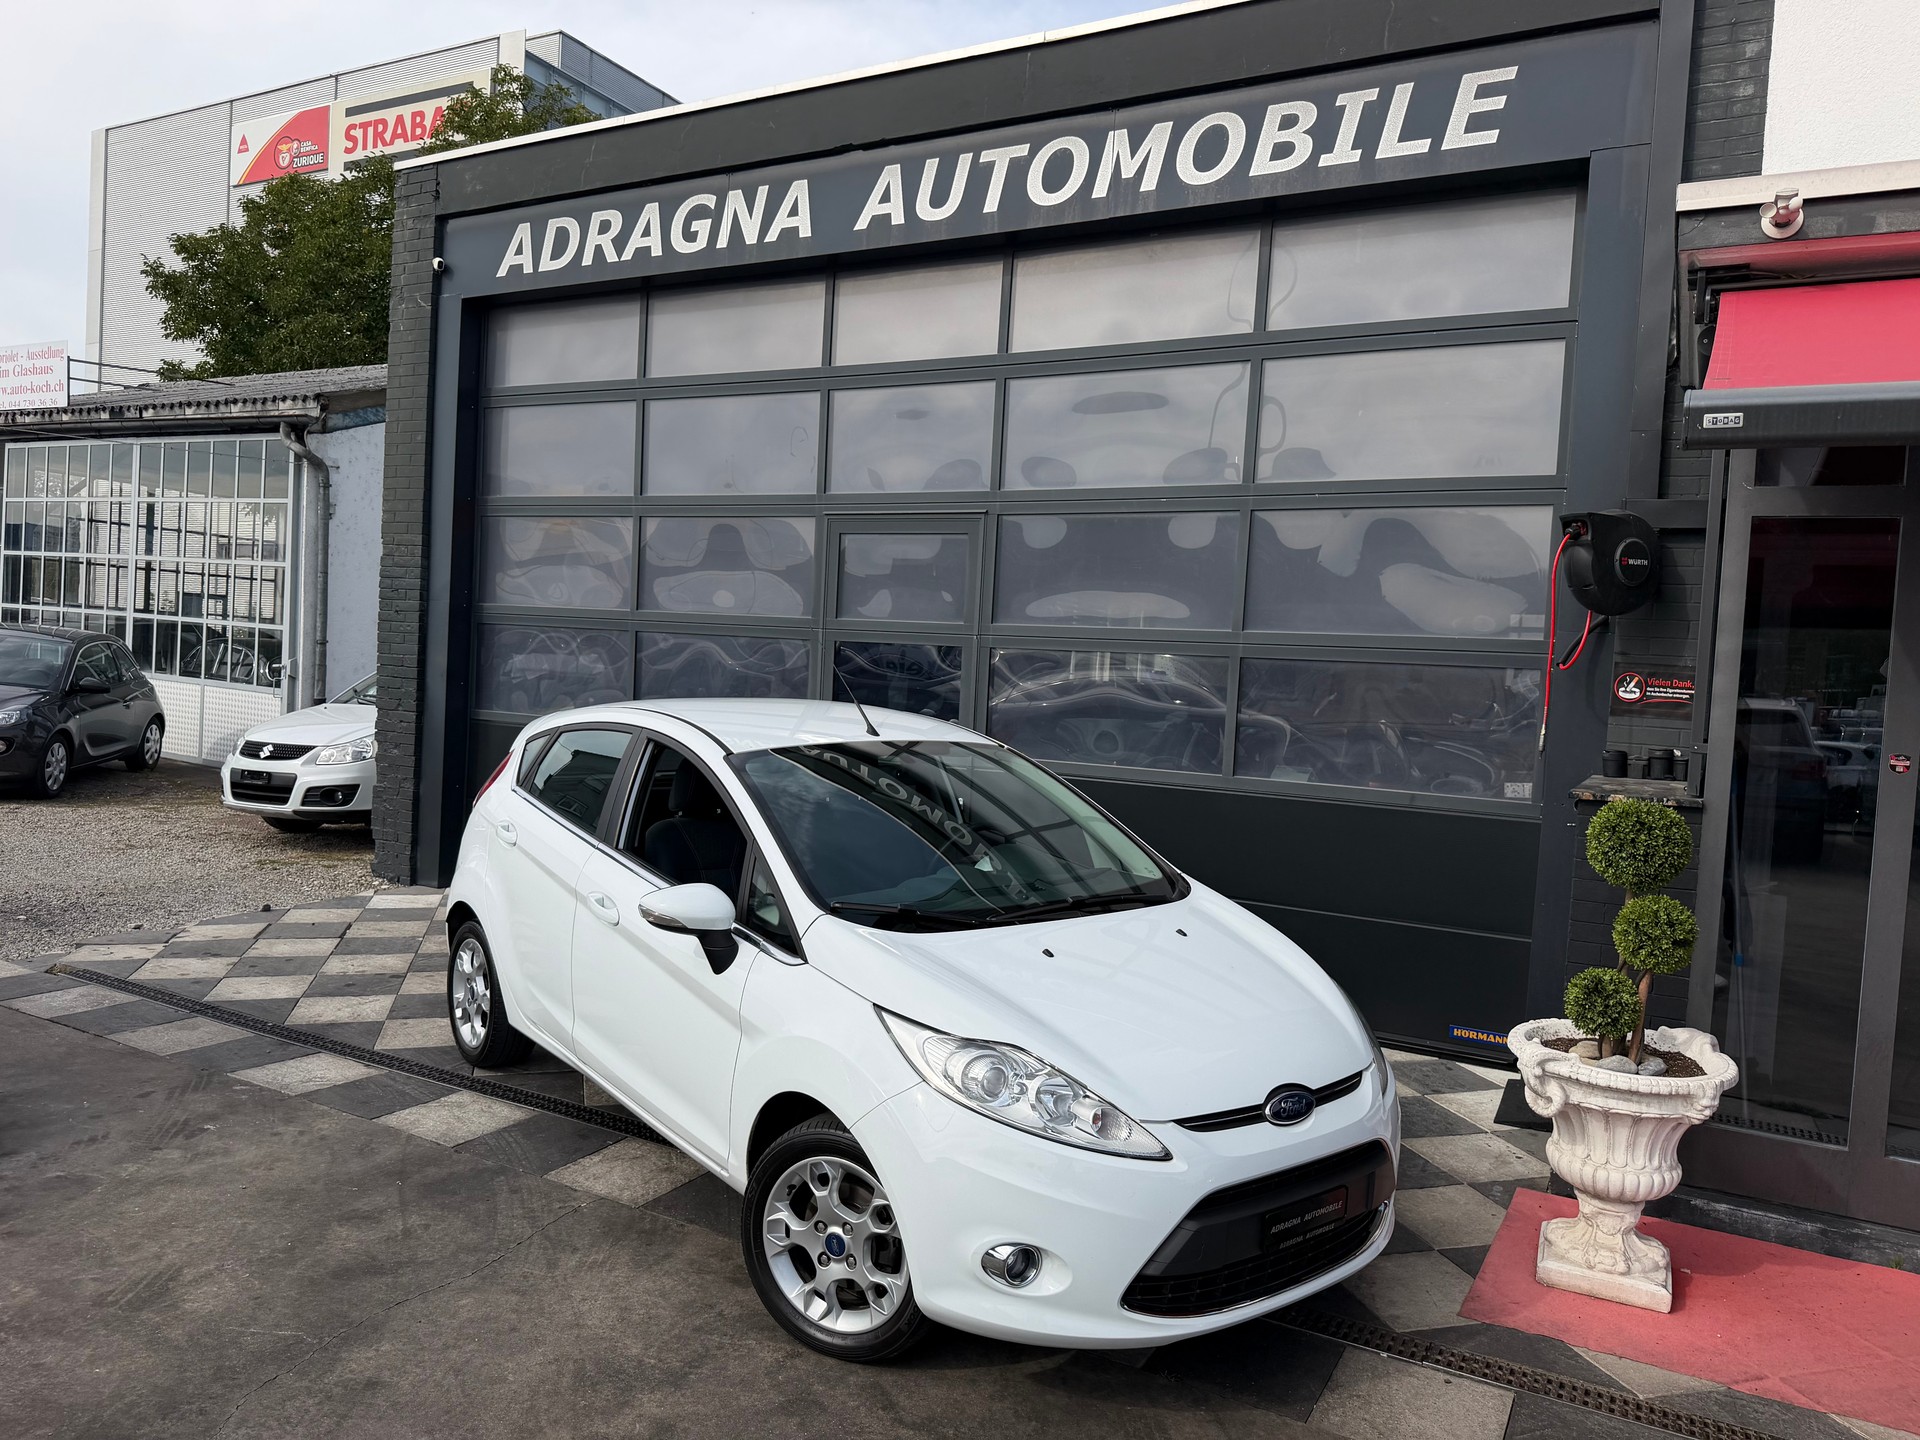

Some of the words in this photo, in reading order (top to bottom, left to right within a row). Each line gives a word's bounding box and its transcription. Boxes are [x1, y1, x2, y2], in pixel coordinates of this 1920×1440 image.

[343, 105, 447, 154] STRABA
[292, 153, 324, 168] ZURIQUE
[496, 179, 812, 278] ADRAGNA
[853, 65, 1519, 231] AUTOMOBILE
[26, 346, 64, 361] Ausstellung
[13, 363, 54, 377] Glashaus
[9, 400, 20, 408] 044
[23, 399, 35, 407] 730
[38, 399, 47, 407] 36
[49, 398, 58, 406] 36
[1647, 678, 1671, 687] Vielen
[1673, 679, 1695, 689] Dank,
[1280, 1097, 1306, 1117] Ford
[1270, 1216, 1301, 1234] ADRAGNA
[1303, 1201, 1343, 1222] AUTOMOBILE
